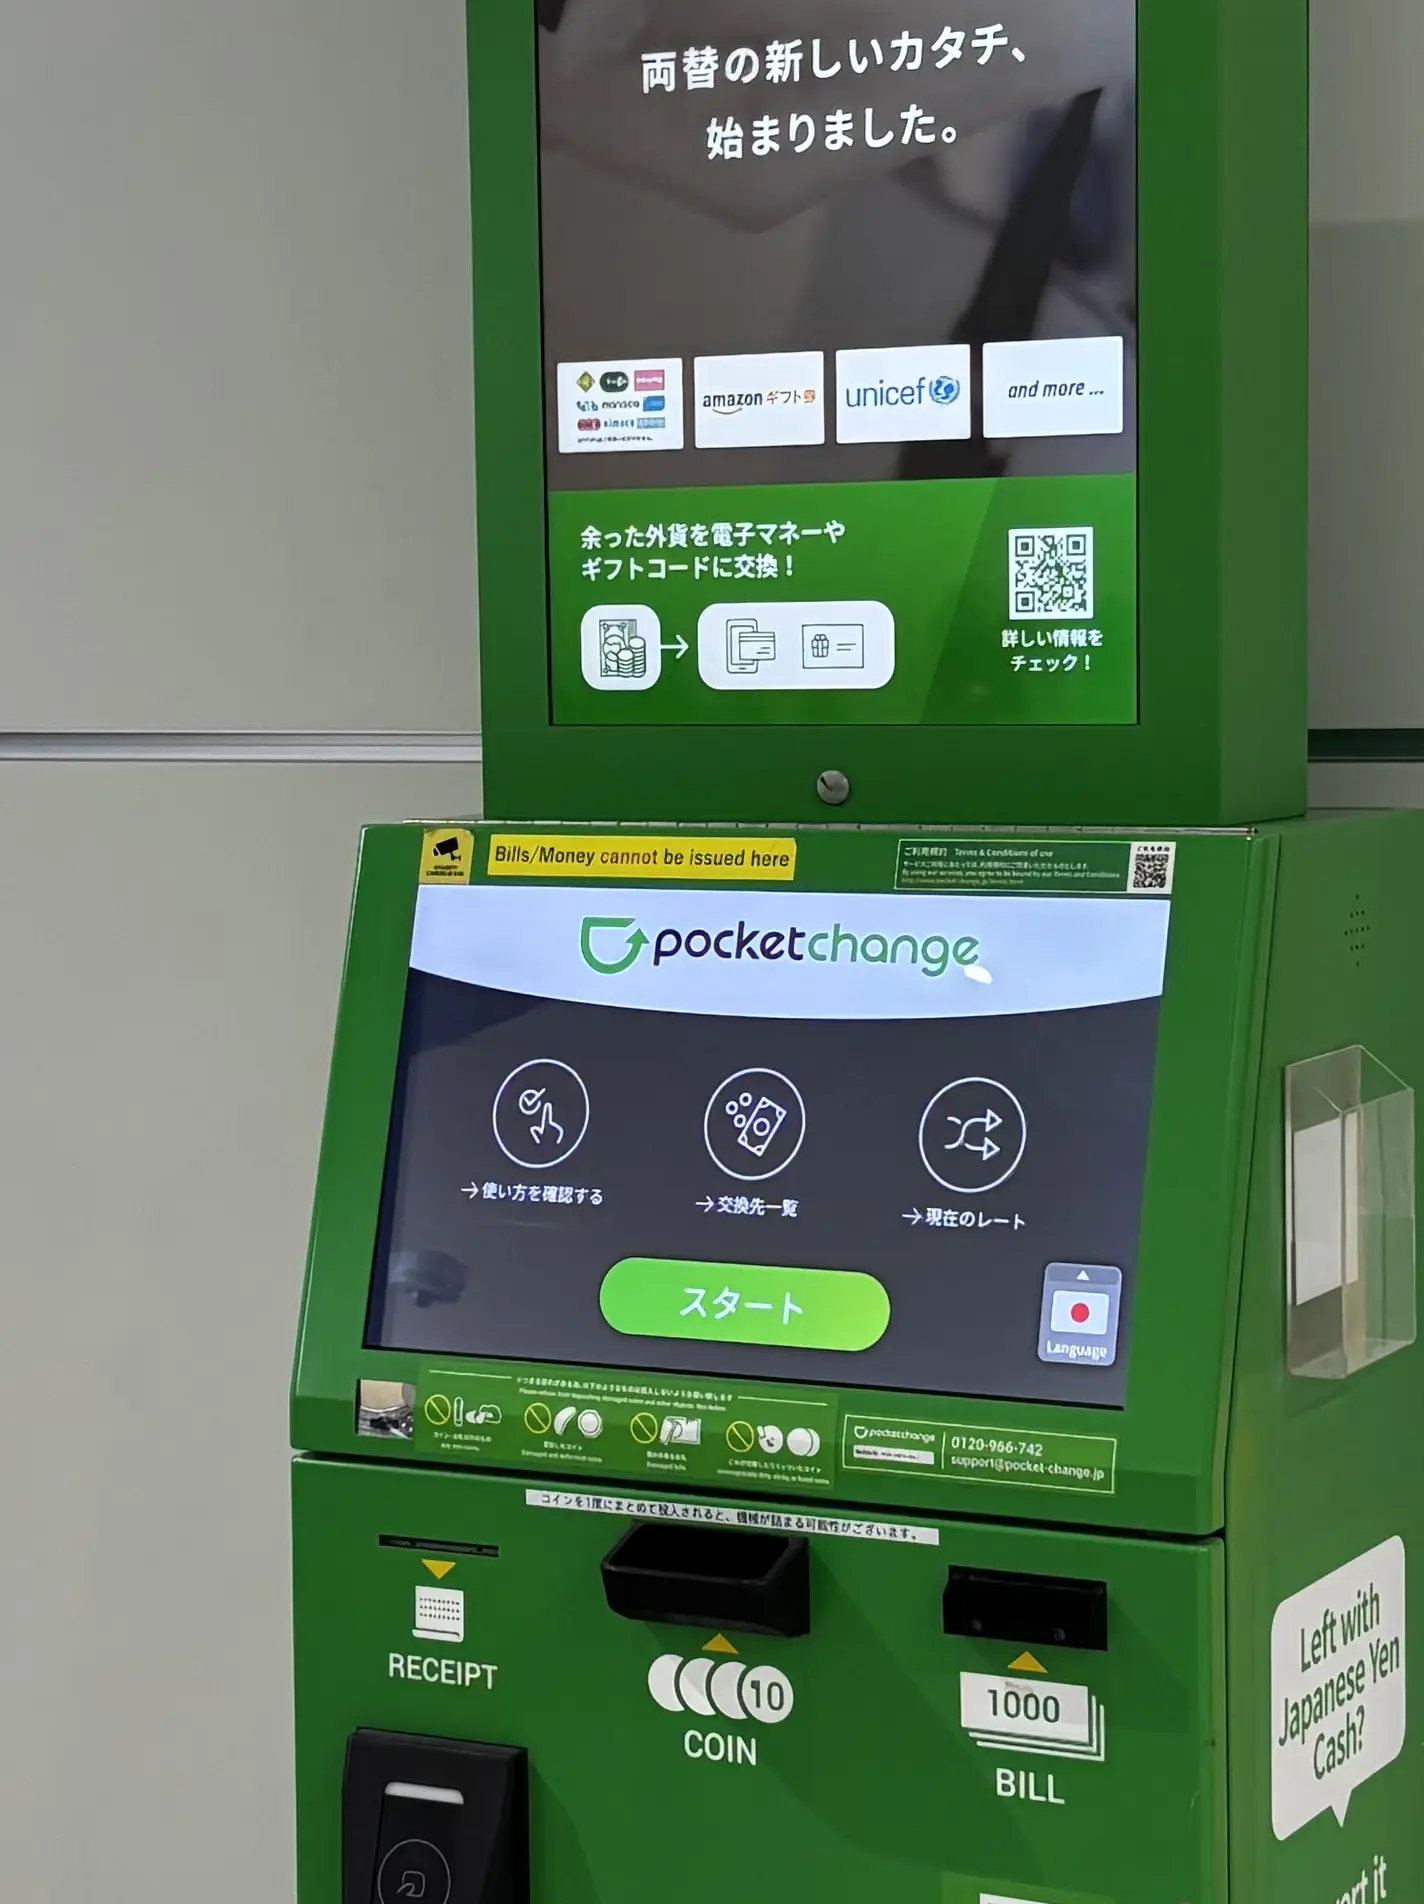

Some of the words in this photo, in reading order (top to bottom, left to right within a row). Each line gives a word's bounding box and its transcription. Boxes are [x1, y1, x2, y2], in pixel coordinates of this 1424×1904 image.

[640, 23, 1027, 95] 両替の新しいカタチ、
[706, 104, 959, 162] 始まりました。
[703, 392, 763, 408] amazon
[846, 377, 926, 408] unicef
[1008, 380, 1039, 398] and
[1042, 381, 1085, 397] more
[580, 520, 845, 549] 余った外貨を電子マネーや
[1002, 629, 1103, 648] 詳しい情報を
[495, 845, 595, 867] Bills/Money
[600, 849, 658, 866] cannot
[663, 849, 684, 866] be
[689, 849, 745, 867] issued
[751, 850, 790, 868] here
[652, 919, 980, 978] pocketchange
[481, 1181, 603, 1205] 使い方を確認する
[717, 1196, 799, 1217] 交換先一覧
[925, 1207, 1025, 1230] 現在のレート
[679, 1285, 803, 1326] スタート
[1047, 1340, 1107, 1360] Language
[1301, 1608, 1337, 1673] Left
[1340, 1582, 1380, 1646] with
[387, 1653, 498, 1691] RECEIPT
[750, 1677, 785, 1712] 10
[988, 1689, 1060, 1723] 1000
[1278, 1658, 1365, 1747] Japanese
[1369, 1636, 1400, 1684] Yen
[683, 1730, 758, 1766] COIN
[1313, 1704, 1365, 1780] Cash?
[995, 1767, 1065, 1805] BILL
[1373, 1855, 1387, 1904] it
